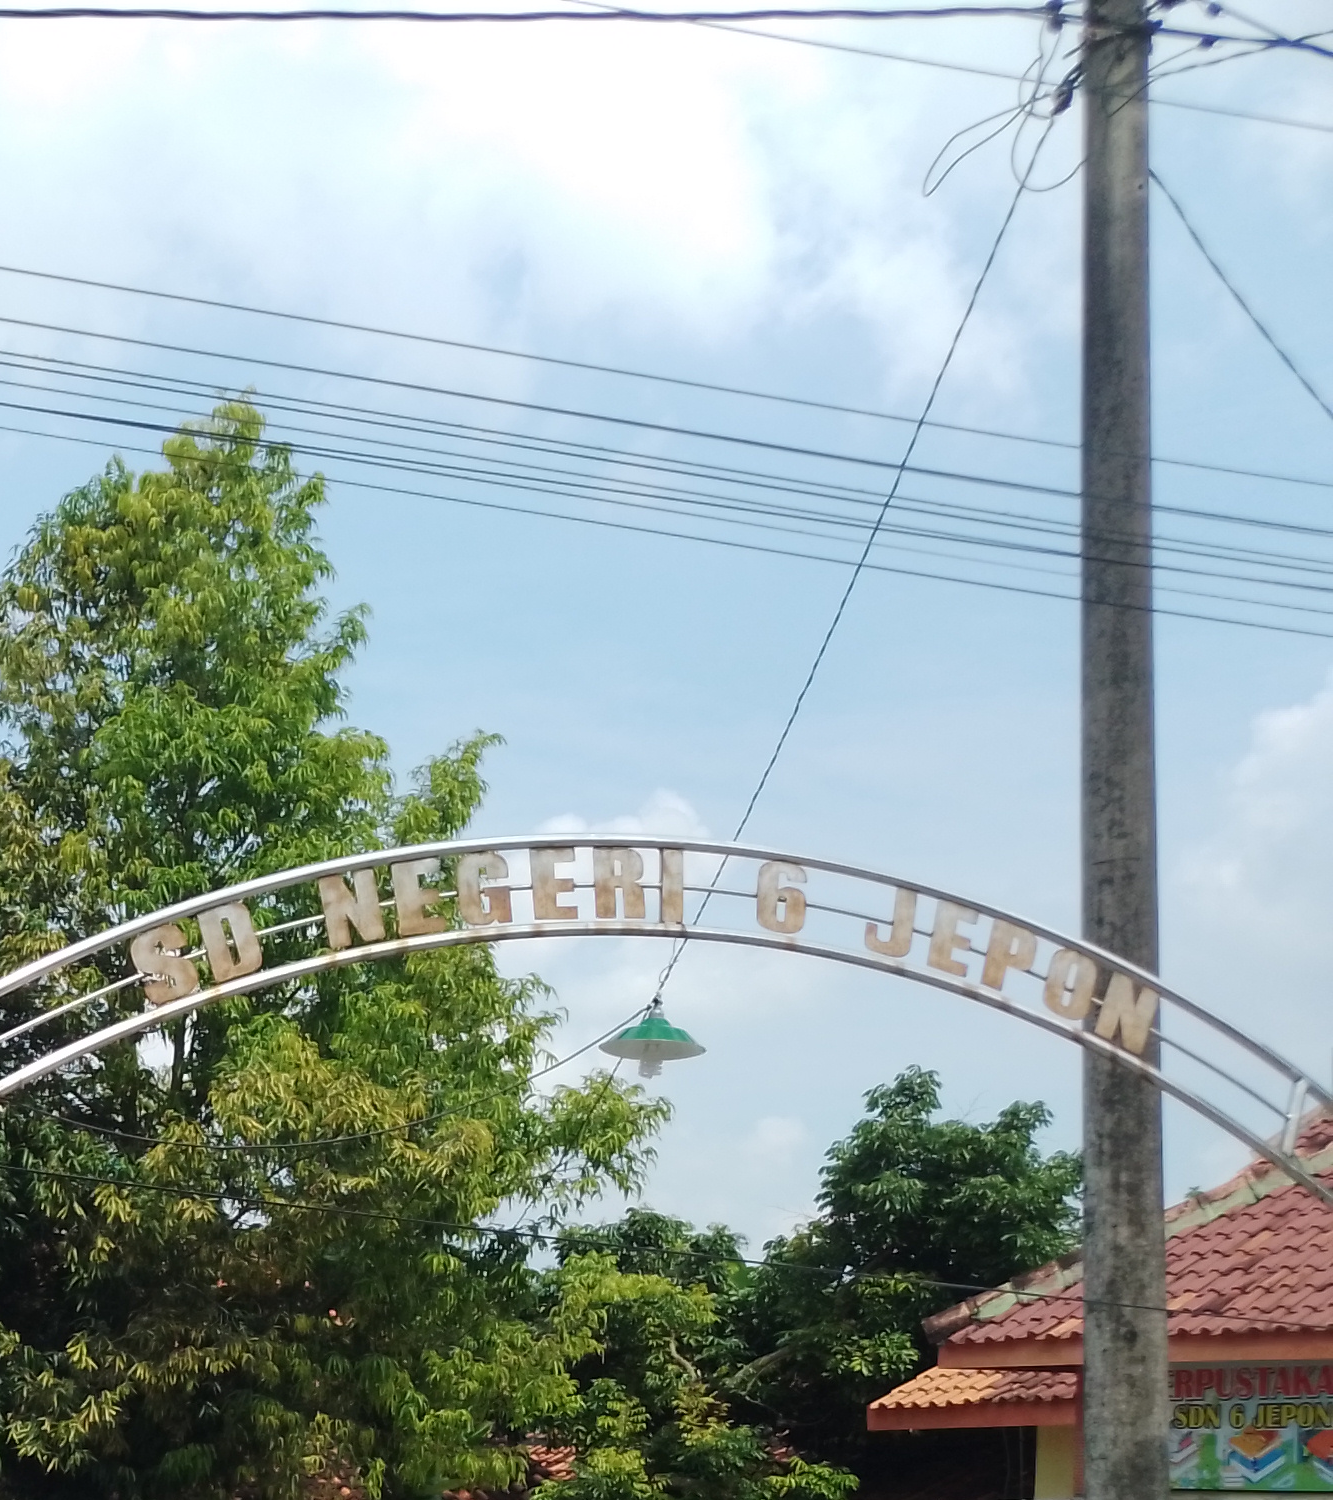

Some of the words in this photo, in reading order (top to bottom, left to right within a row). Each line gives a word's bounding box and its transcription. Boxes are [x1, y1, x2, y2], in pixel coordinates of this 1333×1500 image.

[130, 901, 262, 1004] SD
[318, 847, 684, 948] NEGERI
[757, 860, 807, 934] 6
[865, 887, 1160, 1055] JEPON
[1168, 1366, 1333, 1400] RPUSTAKA
[1172, 1403, 1221, 1429] SDN
[1229, 1403, 1245, 1429] 6
[1253, 1403, 1333, 1429] JEPON
